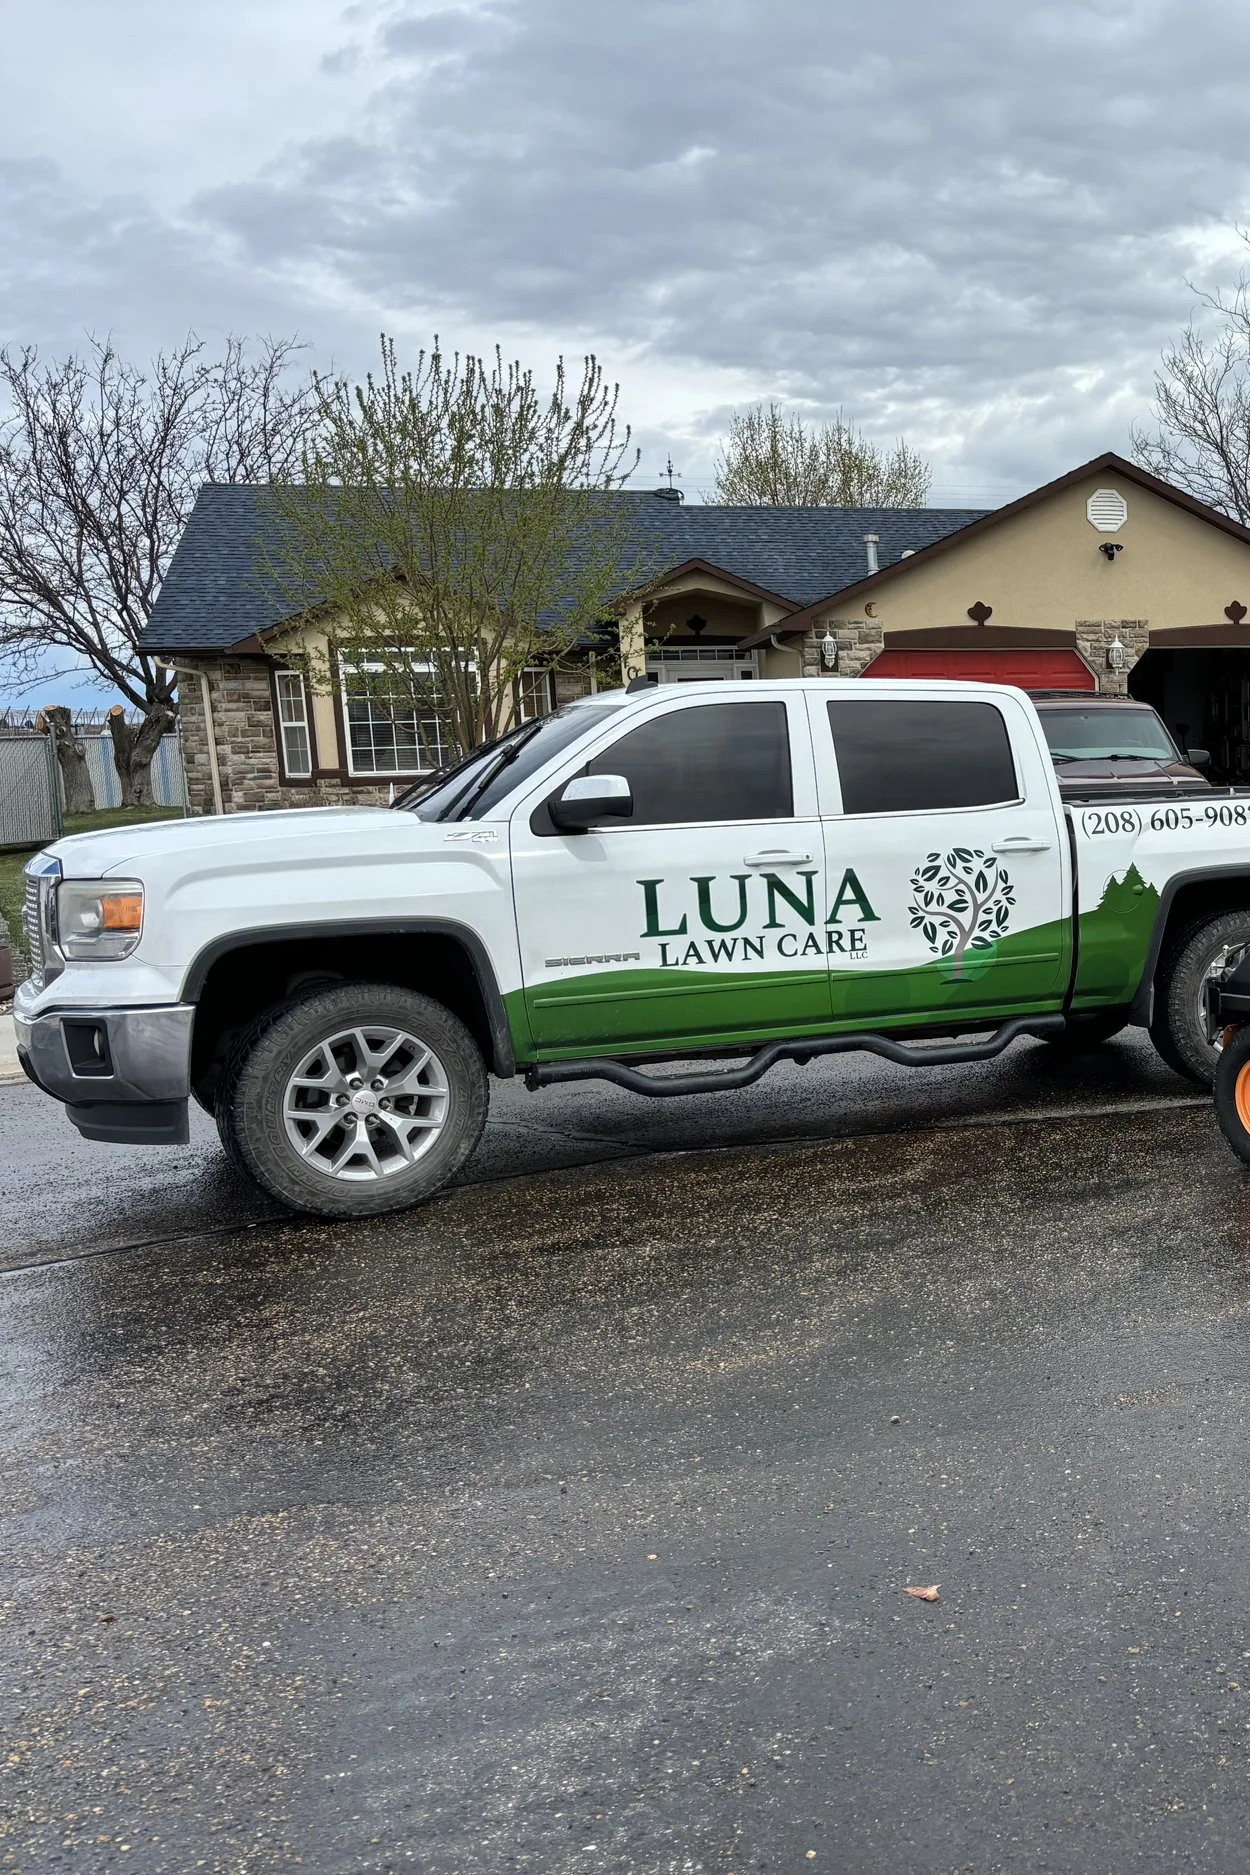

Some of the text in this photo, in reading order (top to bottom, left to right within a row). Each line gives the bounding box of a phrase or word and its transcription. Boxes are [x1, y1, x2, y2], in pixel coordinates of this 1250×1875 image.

[1081, 809, 1143, 840] (208)
[635, 868, 882, 938] LUNA
[658, 928, 868, 968] LAWN CARE
[849, 951, 869, 960] LLC
[544, 952, 641, 968] SIERRA
[353, 1096, 376, 1108] GMC
